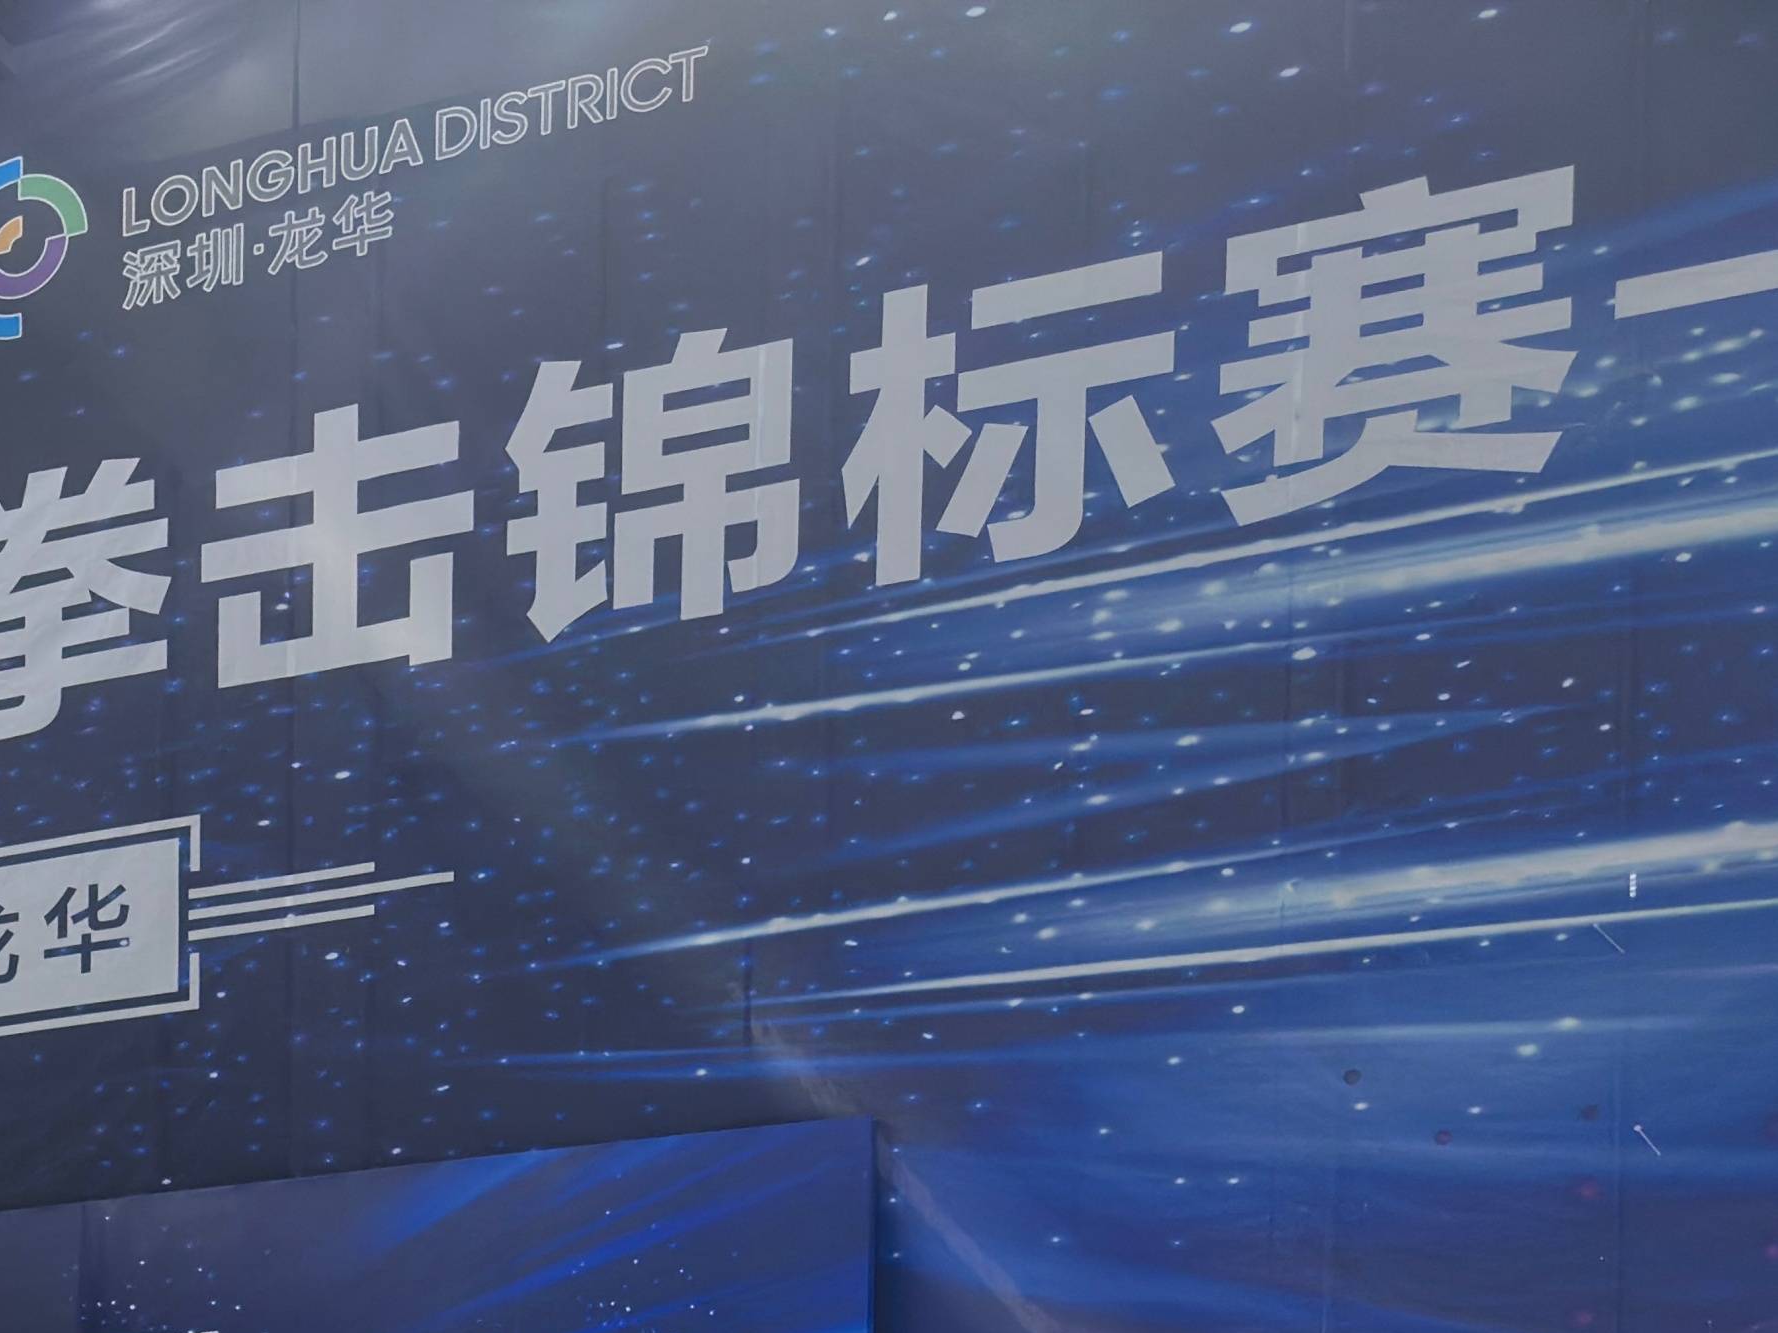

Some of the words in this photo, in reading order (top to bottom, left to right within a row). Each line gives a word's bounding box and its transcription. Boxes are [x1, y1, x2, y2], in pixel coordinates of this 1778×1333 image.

[122, 119, 423, 236] LONGHUA
[435, 45, 709, 161] DISTRICT
[122, 192, 394, 311] 深圳·龙华
